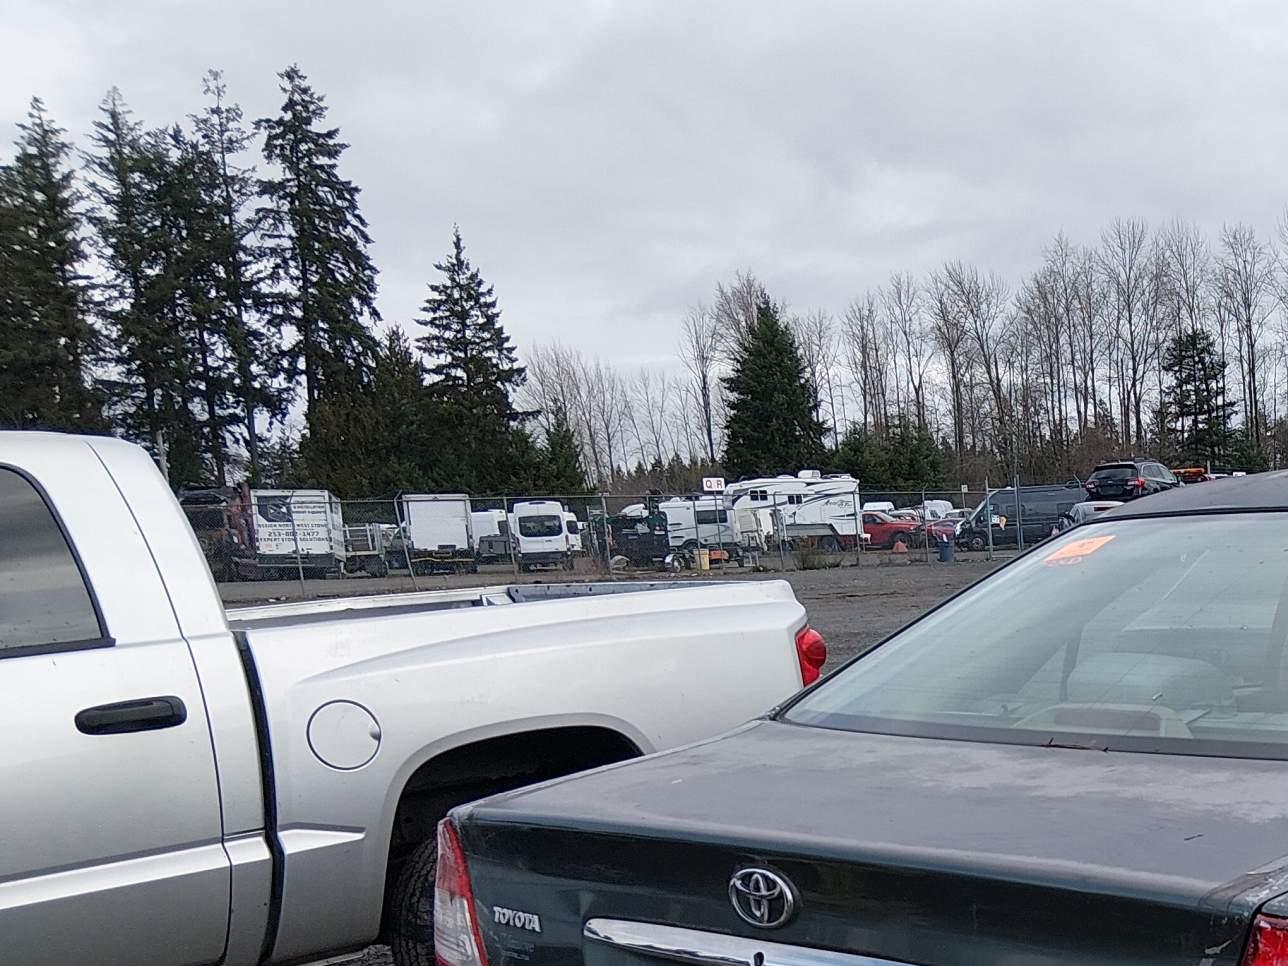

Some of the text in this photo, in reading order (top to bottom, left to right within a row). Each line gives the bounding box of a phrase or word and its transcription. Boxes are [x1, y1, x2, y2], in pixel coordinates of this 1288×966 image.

[705, 480, 723, 489] Q R
[493, 906, 541, 933] TOYOTA
